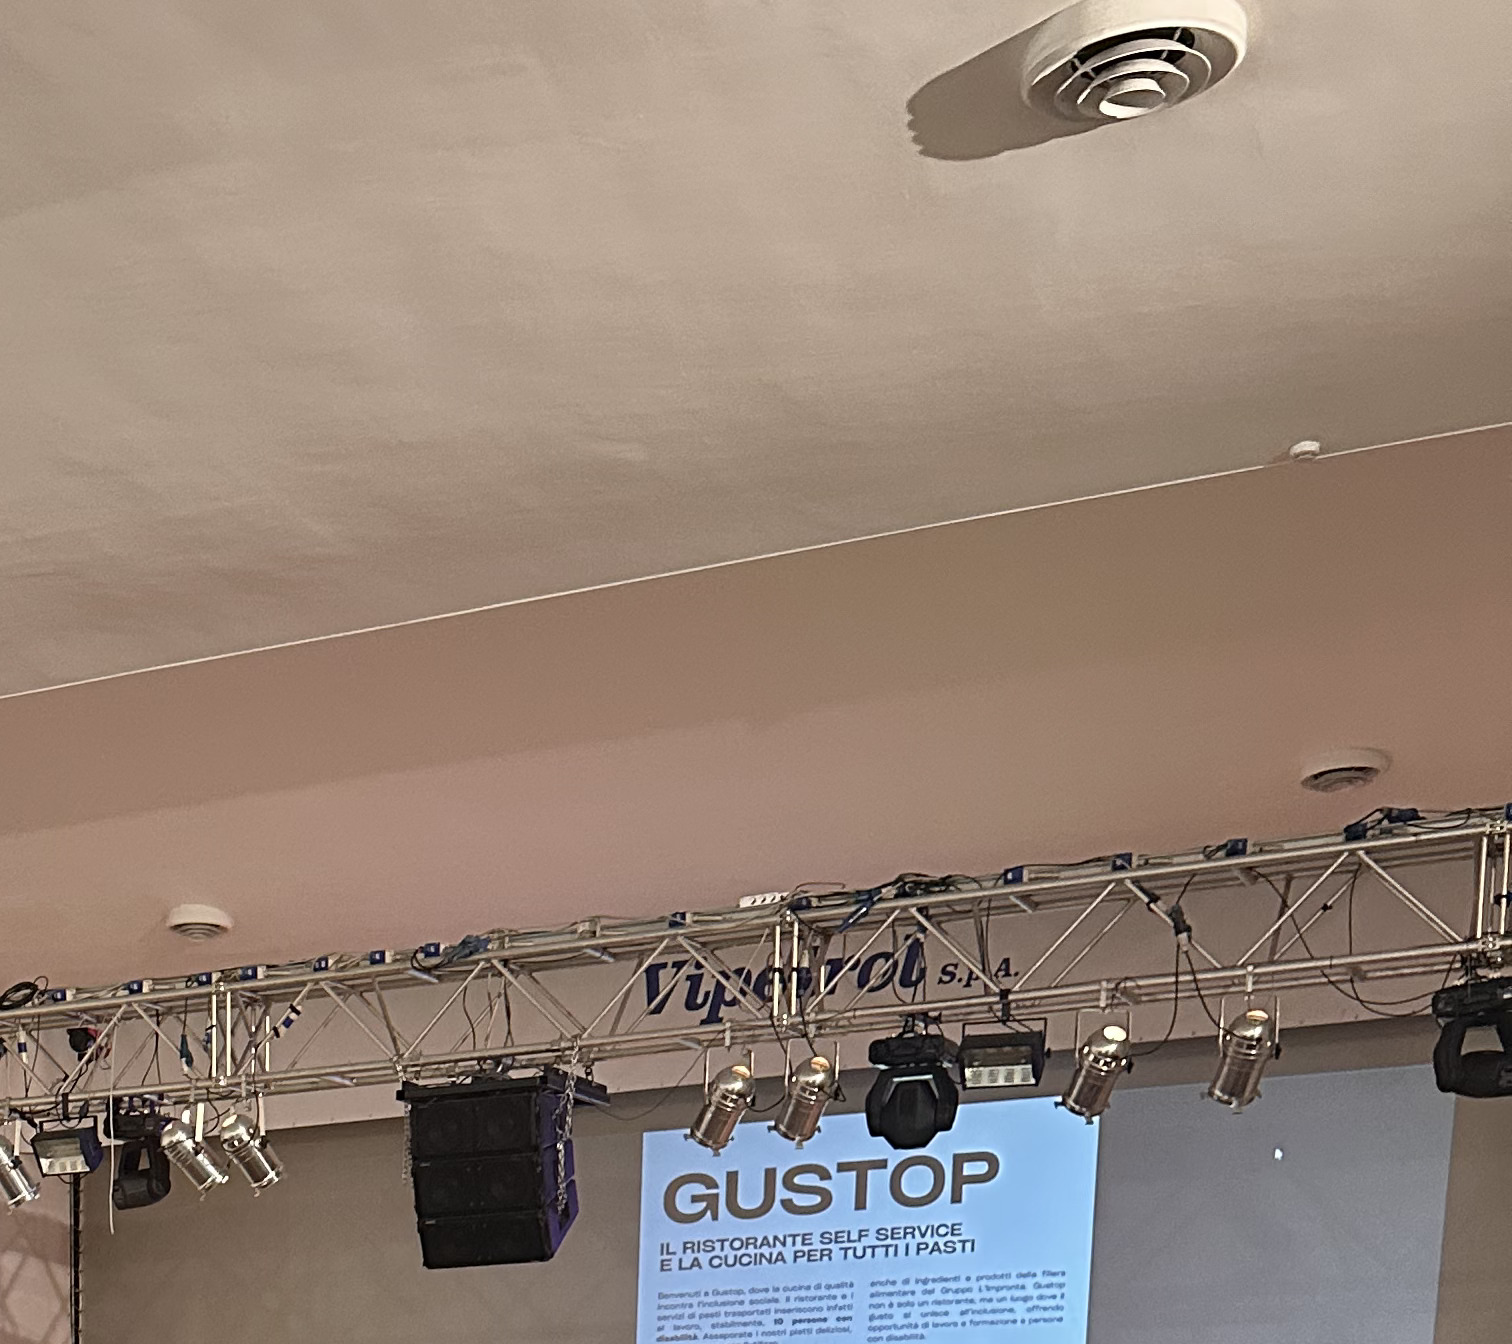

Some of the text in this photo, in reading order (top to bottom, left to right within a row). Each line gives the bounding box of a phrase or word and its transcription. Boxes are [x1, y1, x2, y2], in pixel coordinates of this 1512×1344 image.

[663, 1151, 1000, 1224] GUSTOP
[660, 1222, 963, 1257] IL RISTORANTE SELF SERVICE
[660, 1238, 976, 1272] E LA CUCINA PER TUTTI I PASTI
[748, 1286, 769, 1294] dove
[782, 1284, 811, 1292] cucina
